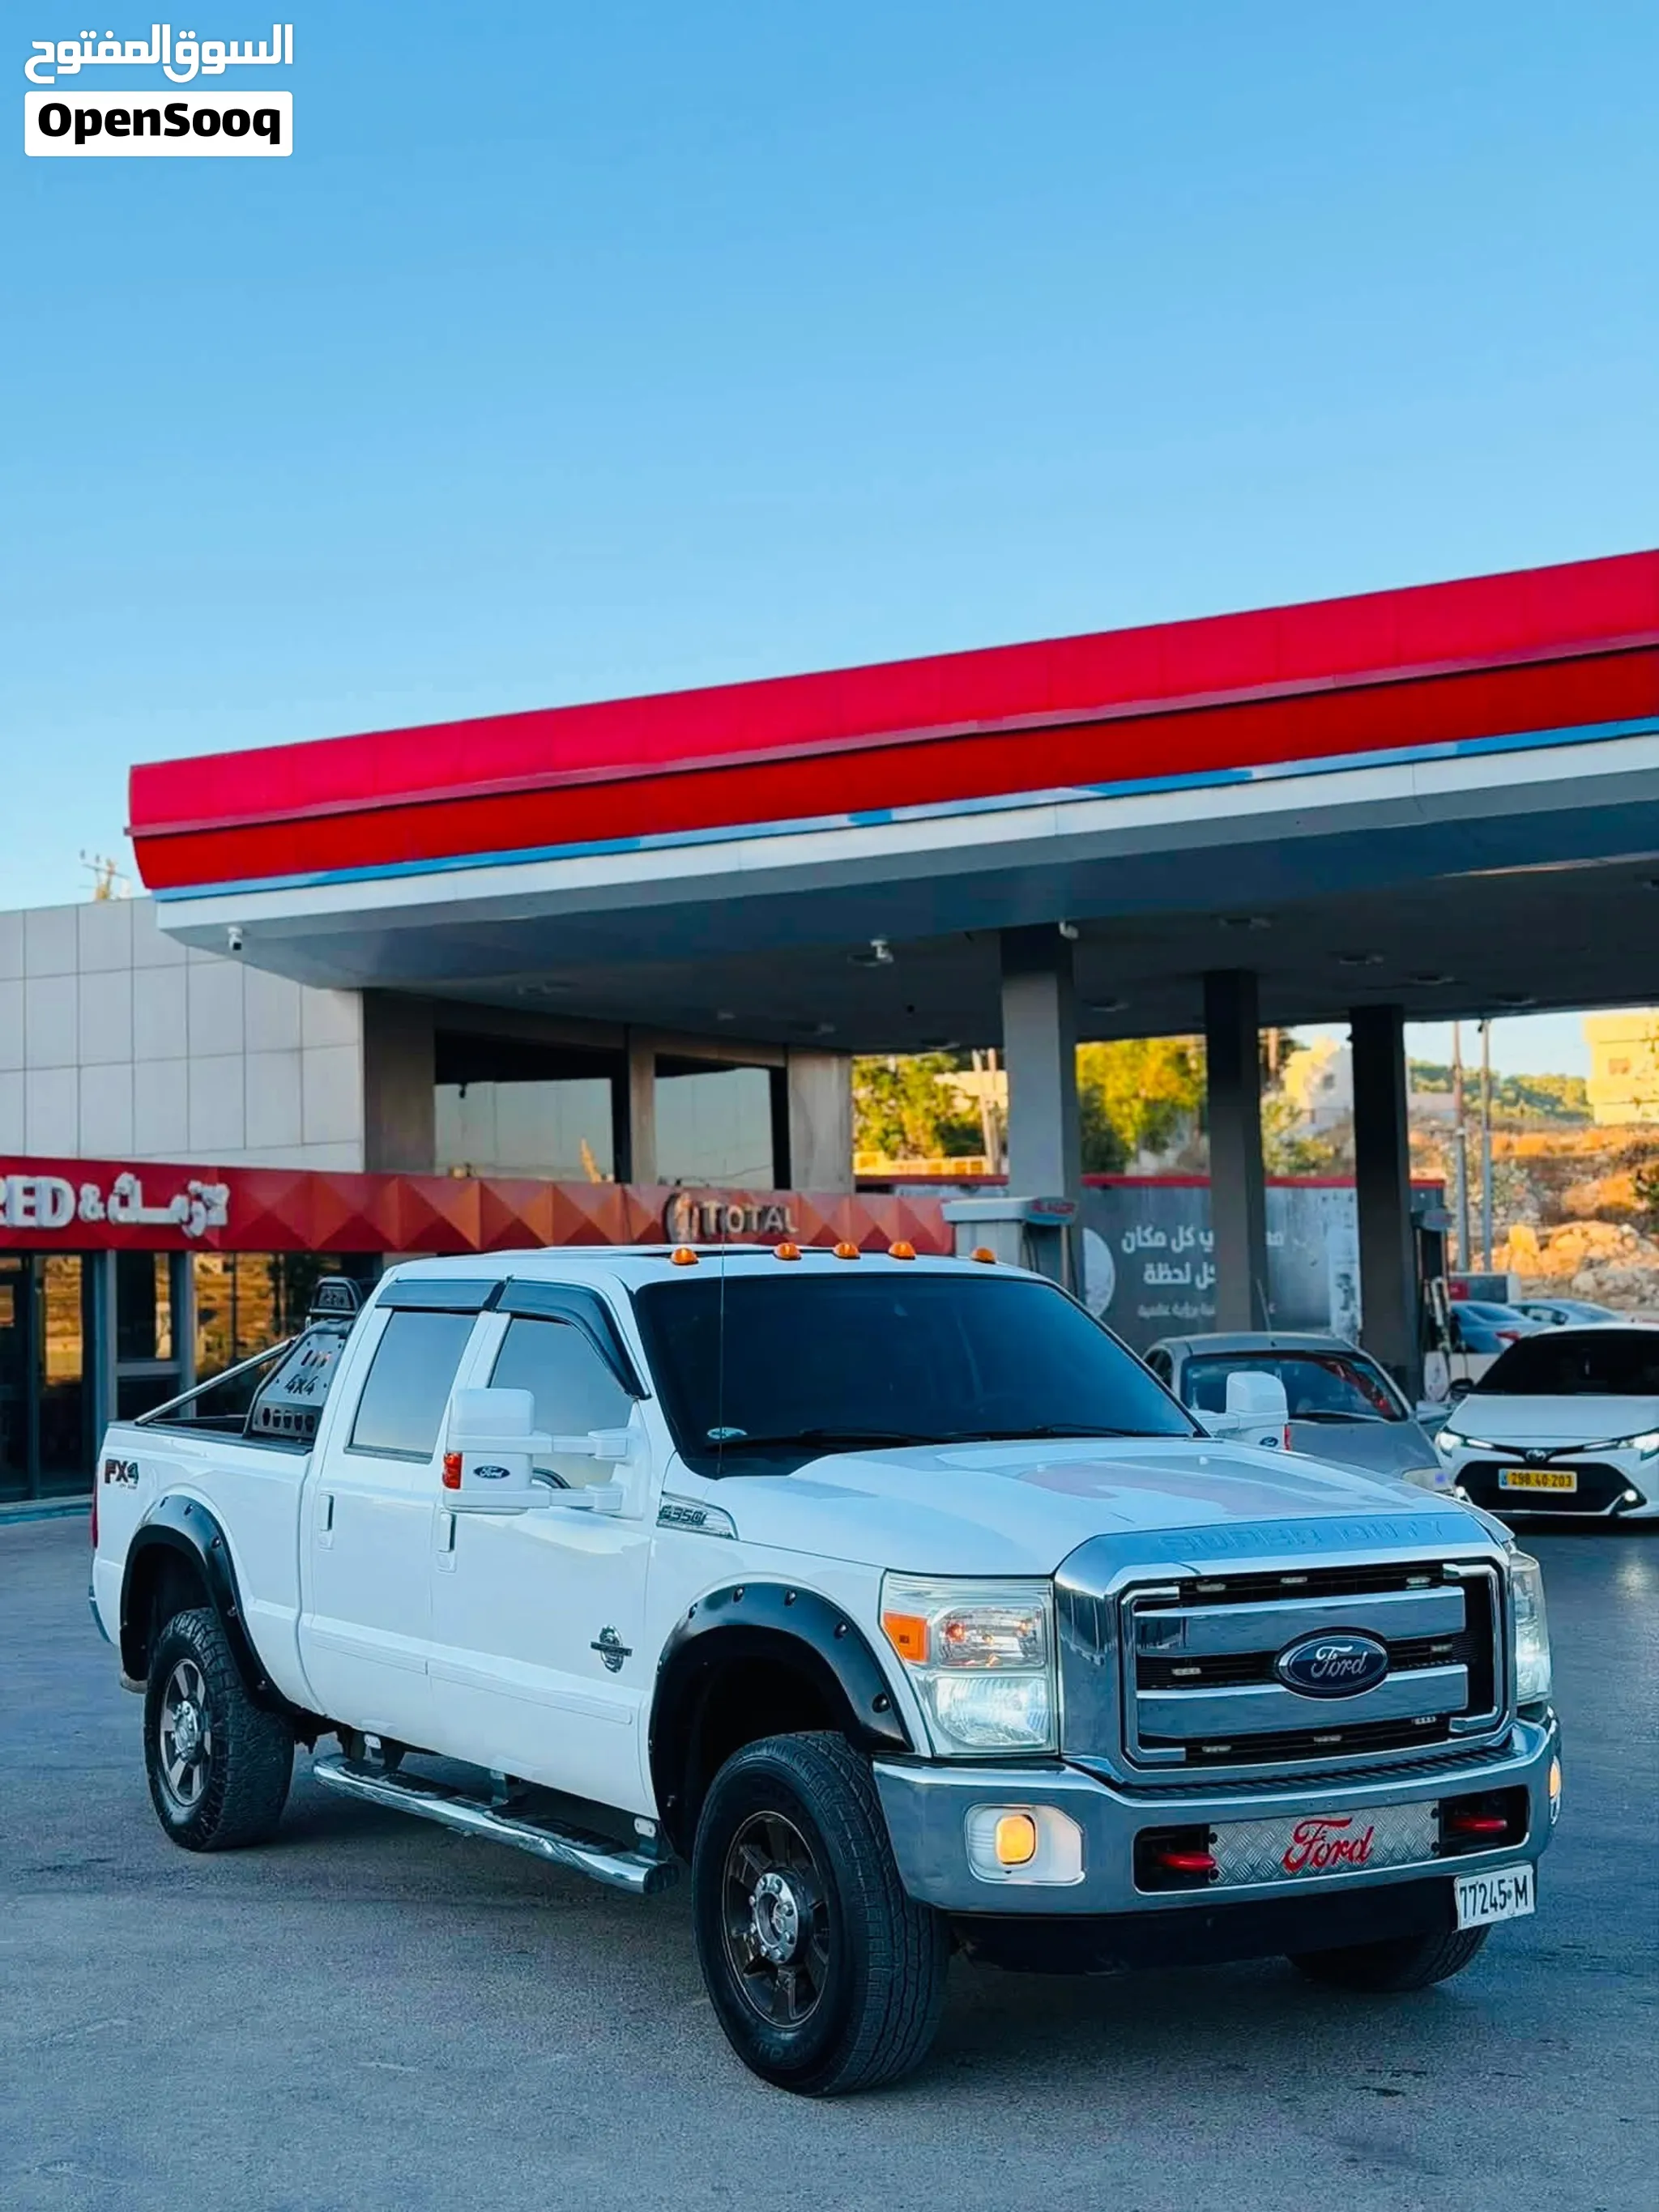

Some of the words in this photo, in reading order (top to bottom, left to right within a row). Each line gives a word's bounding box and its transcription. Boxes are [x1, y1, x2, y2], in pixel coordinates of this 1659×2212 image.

[78, 1183, 105, 1221] &
[702, 1200, 800, 1234] TOTAL
[1121, 1225, 1167, 1254] مكان
[1143, 1261, 1191, 1285] لحظة
[104, 1458, 139, 1484] FX4
[1311, 1646, 1368, 1678] Ford
[1282, 1817, 1375, 1873] Ford
